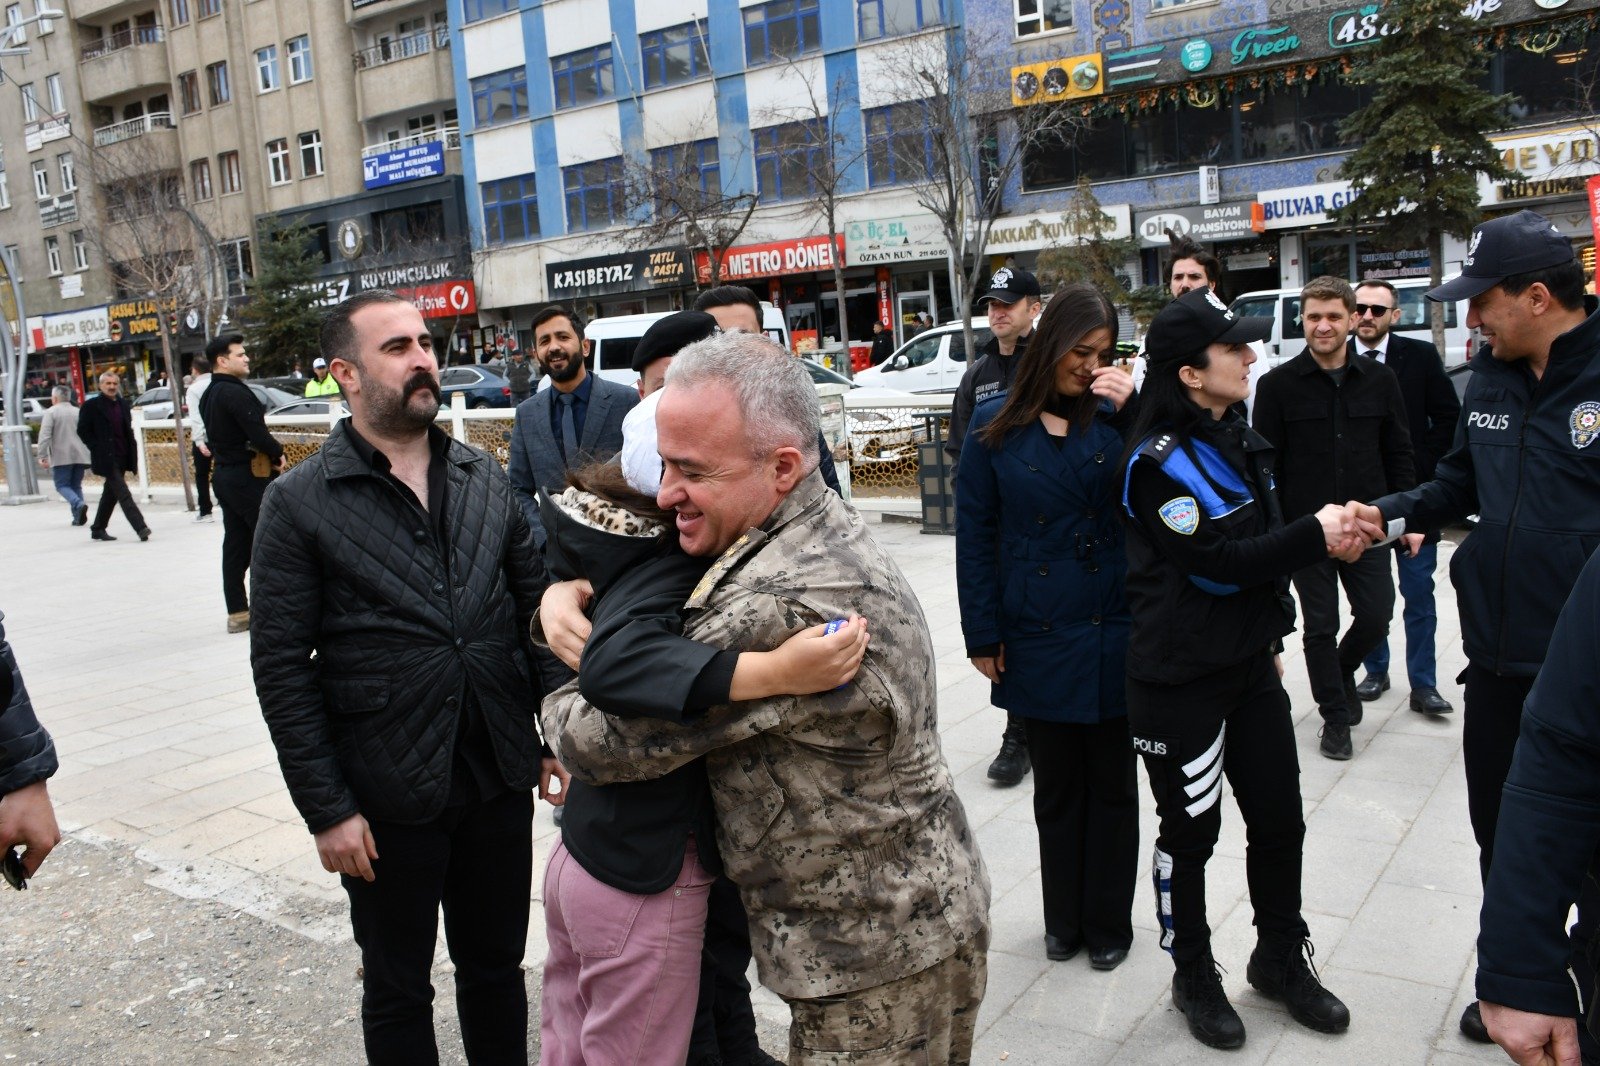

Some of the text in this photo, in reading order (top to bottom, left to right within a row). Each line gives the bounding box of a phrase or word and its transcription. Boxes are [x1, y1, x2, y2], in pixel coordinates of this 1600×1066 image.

[1230, 25, 1300, 65] Green
[1204, 206, 1241, 219] BAYAN
[1264, 195, 1326, 220] BULVAR
[1192, 219, 1253, 234] PANSİYONU
[650, 251, 676, 265] TATLI
[729, 249, 781, 276] METRO
[860, 251, 891, 262] ÖZKAN
[893, 250, 913, 259] KUN
[360, 262, 451, 289] KUYUMCULUK
[643, 262, 684, 278] & PASTA
[880, 280, 890, 326] METRO
[80, 318, 106, 334] GOLD
[1467, 411, 1509, 430] POLİS
